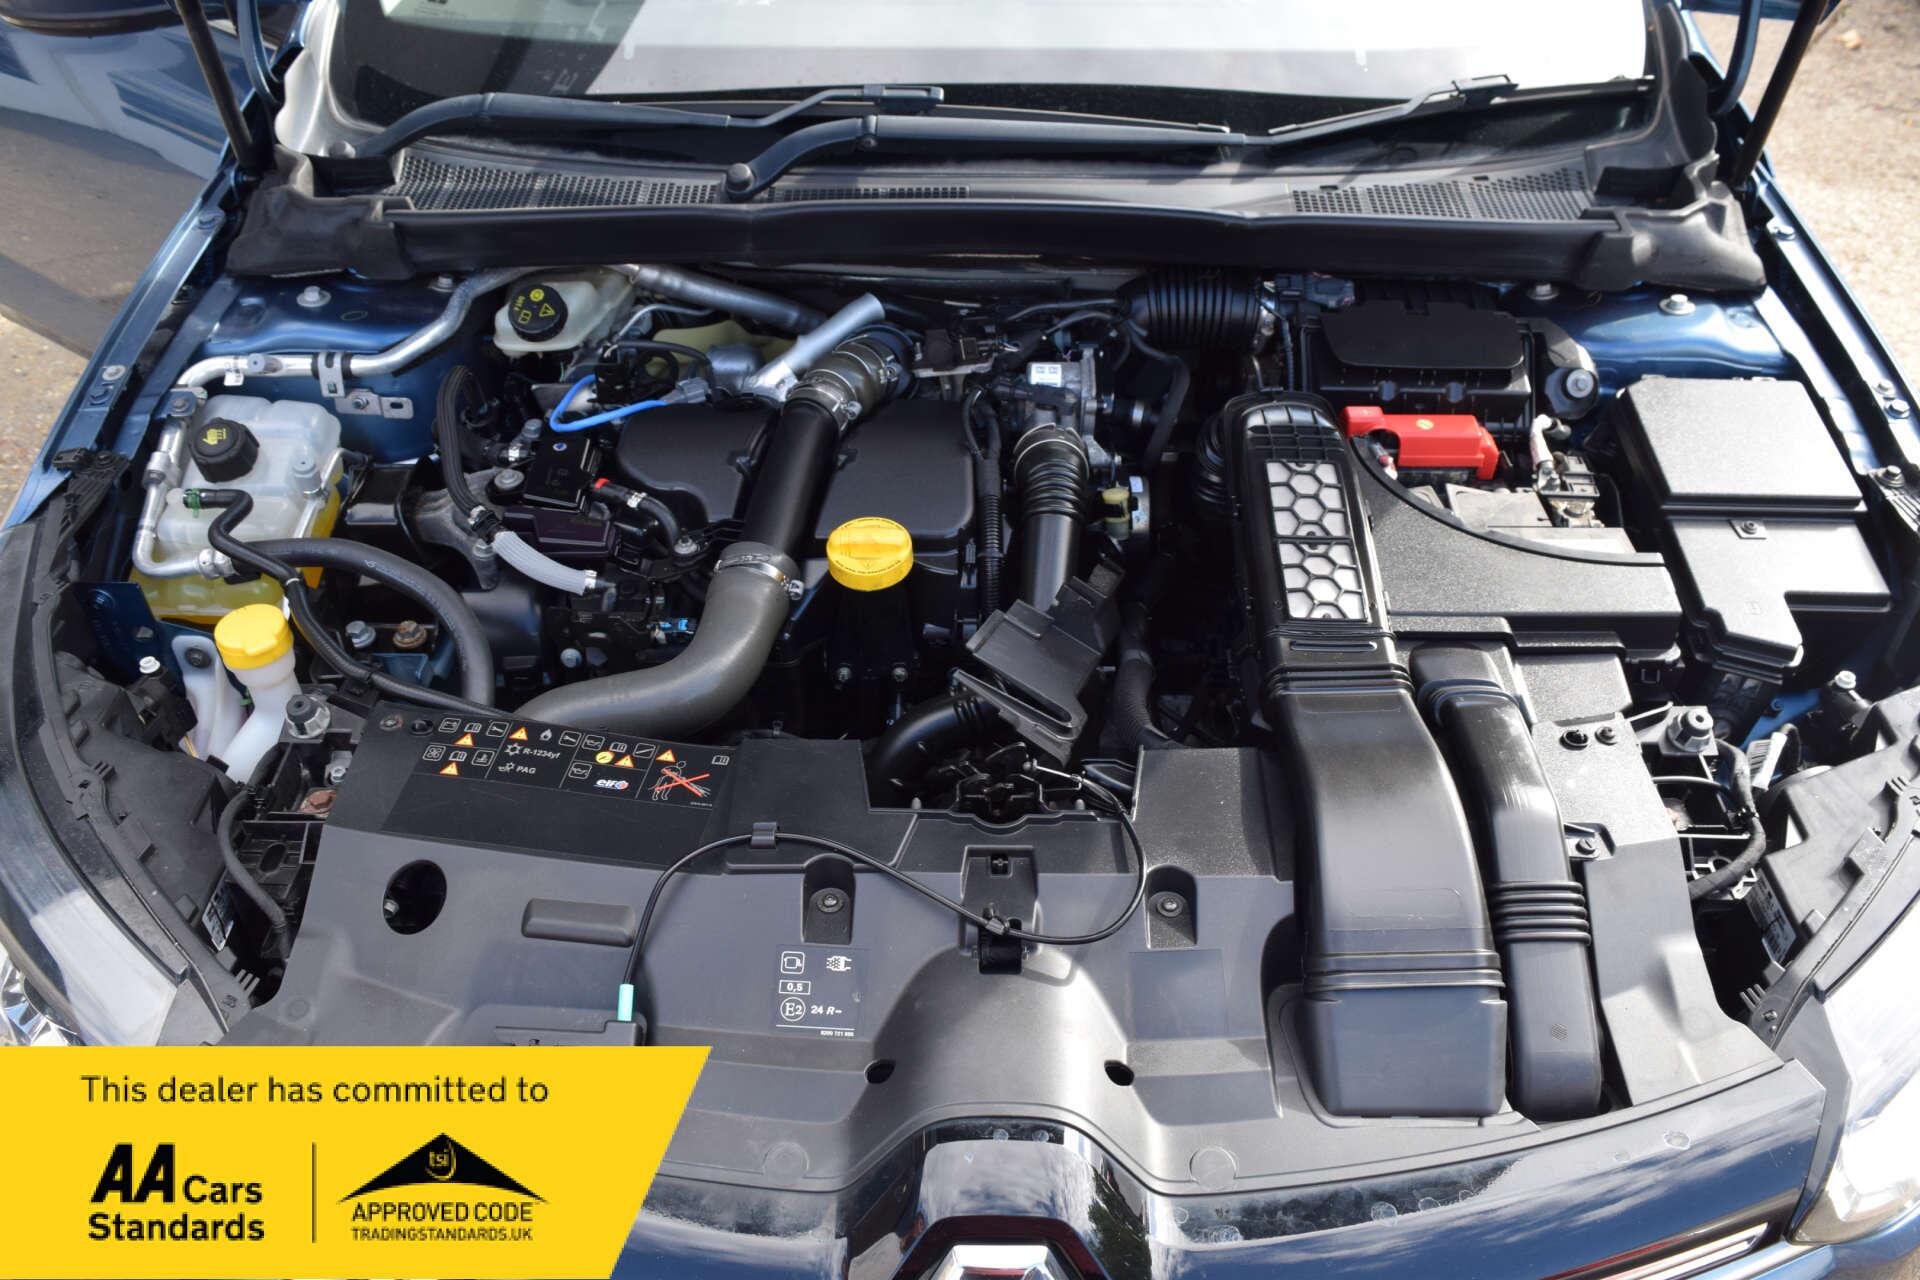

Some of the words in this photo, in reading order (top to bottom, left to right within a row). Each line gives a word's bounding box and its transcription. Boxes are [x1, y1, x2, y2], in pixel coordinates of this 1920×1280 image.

[523, 748, 560, 759] R-1234yf
[516, 766, 536, 774] PAG
[595, 780, 616, 788] elf
[787, 983, 803, 993] 0,5
[785, 1003, 802, 1016] E2
[811, 1005, 823, 1014] 24
